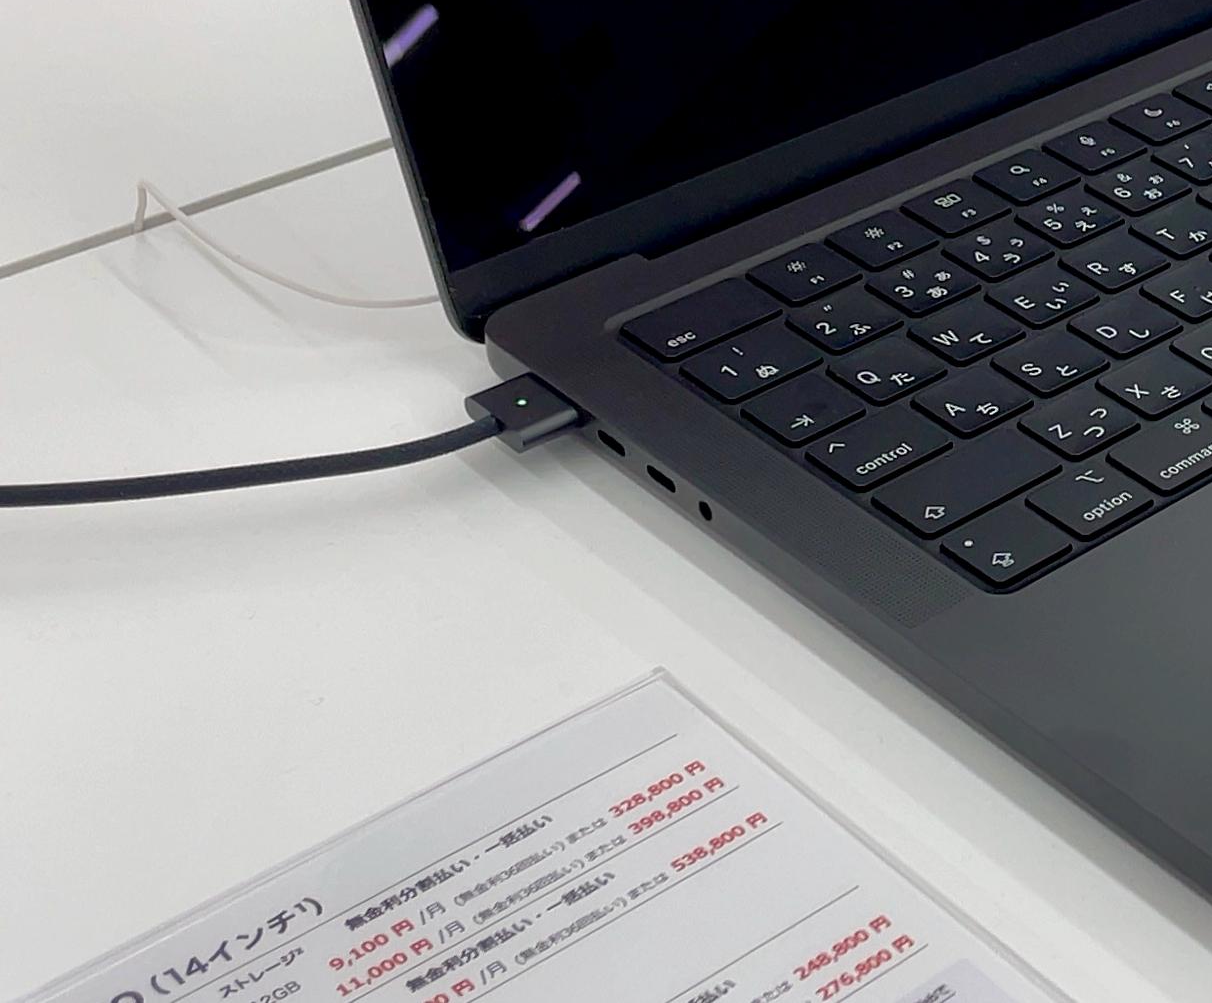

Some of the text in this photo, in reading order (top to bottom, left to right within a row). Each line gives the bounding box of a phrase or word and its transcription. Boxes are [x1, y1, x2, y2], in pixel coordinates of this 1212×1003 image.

[1178, 157, 1194, 168] 7
[1113, 187, 1132, 198] 6
[1043, 218, 1063, 230] 5
[1156, 228, 1175, 240] T
[974, 251, 990, 263] 4
[1086, 262, 1110, 275] R
[1118, 262, 1137, 275] す
[895, 285, 914, 298] 3
[1169, 289, 1185, 303] F
[1013, 296, 1036, 310] E
[1045, 298, 1067, 310] い
[816, 322, 837, 335] 2
[850, 323, 871, 335] ふ
[1096, 326, 1118, 339] D
[1128, 329, 1150, 339] し
[667, 331, 696, 347] esc
[932, 330, 960, 346] W
[969, 333, 992, 344] て
[721, 365, 738, 377] 1
[1021, 363, 1042, 376] S
[1056, 365, 1078, 377] と
[856, 371, 882, 385] Q
[890, 372, 915, 386] た
[1125, 383, 1150, 399] X
[945, 403, 966, 417] A
[976, 402, 998, 416] ち
[1048, 423, 1073, 439] Z
[1083, 426, 1105, 438] つ
[856, 443, 912, 475] control
[1083, 491, 1132, 522] option
[329, 933, 389, 971] 9,100
[391, 918, 415, 938] 円
[608, 772, 685, 818] 328,800
[684, 760, 706, 777] 円
[336, 952, 408, 997] 11,000
[410, 937, 434, 956] 円
[627, 789, 703, 836] 398,800
[704, 776, 725, 793] 円
[451, 979, 475, 997] 円
[670, 826, 745, 873] 538,800
[746, 810, 768, 828] 円
[793, 914, 891, 981] 248,800 円
[816, 949, 892, 1002] 276,800
[892, 934, 915, 954] 円
